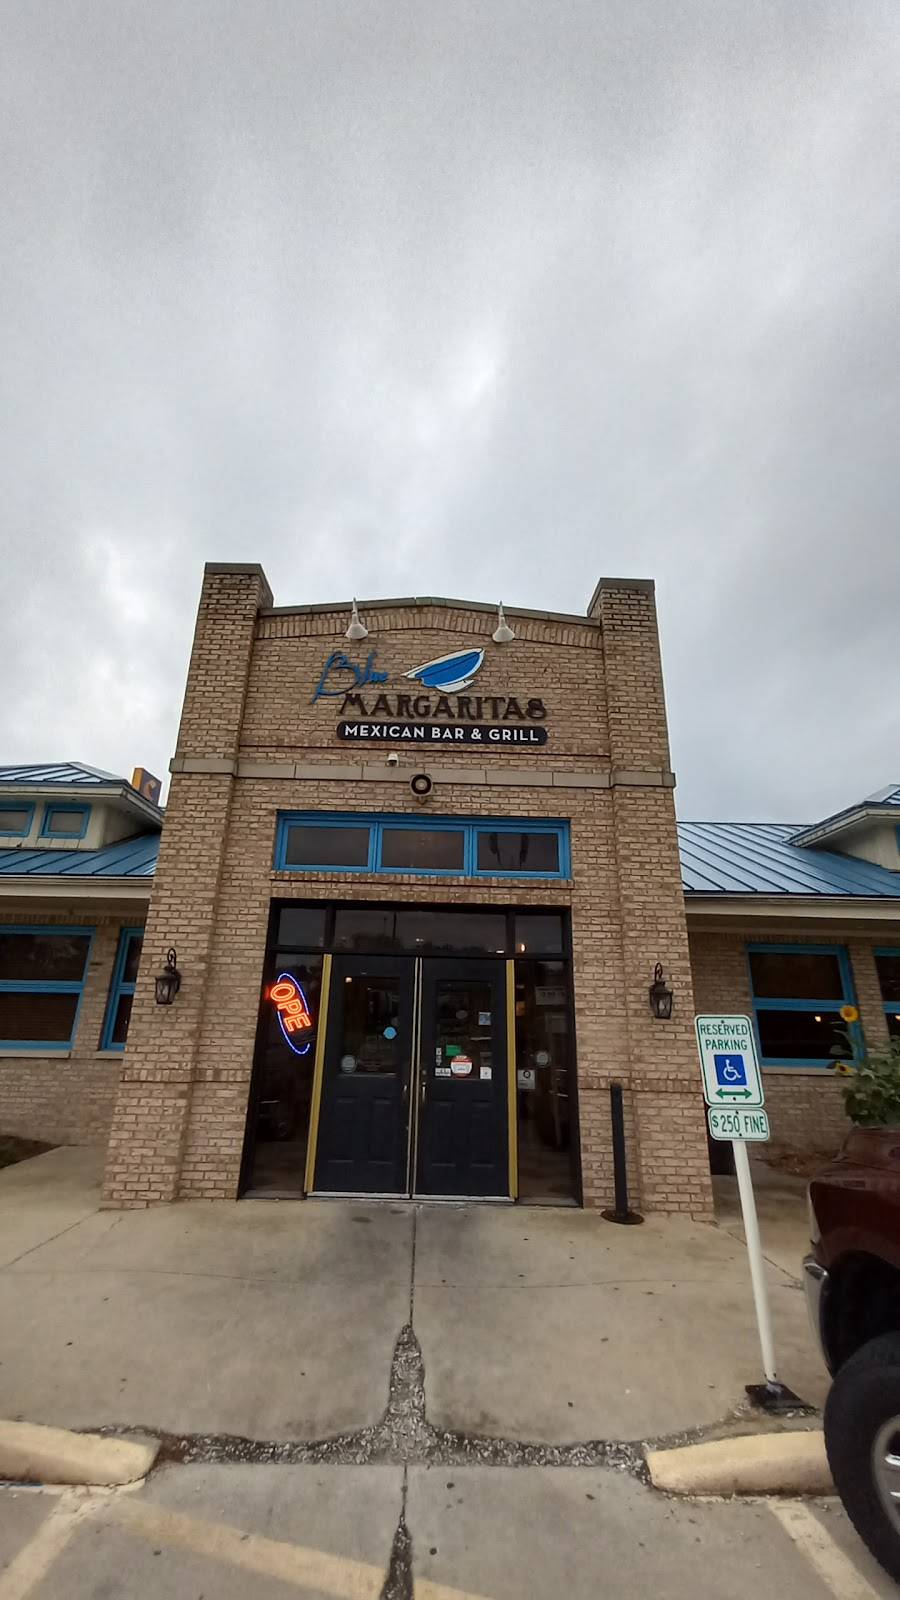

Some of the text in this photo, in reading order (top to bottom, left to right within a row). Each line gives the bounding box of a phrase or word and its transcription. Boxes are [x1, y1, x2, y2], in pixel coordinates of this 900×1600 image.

[339, 693, 548, 720] MARGARITAS
[344, 725, 539, 742] MEXICAN BAR & GRILL
[270, 983, 314, 1041] OPE
[700, 1024, 748, 1035] RESERVED
[705, 1039, 748, 1051] PARKING
[744, 1116, 767, 1133] FINE
